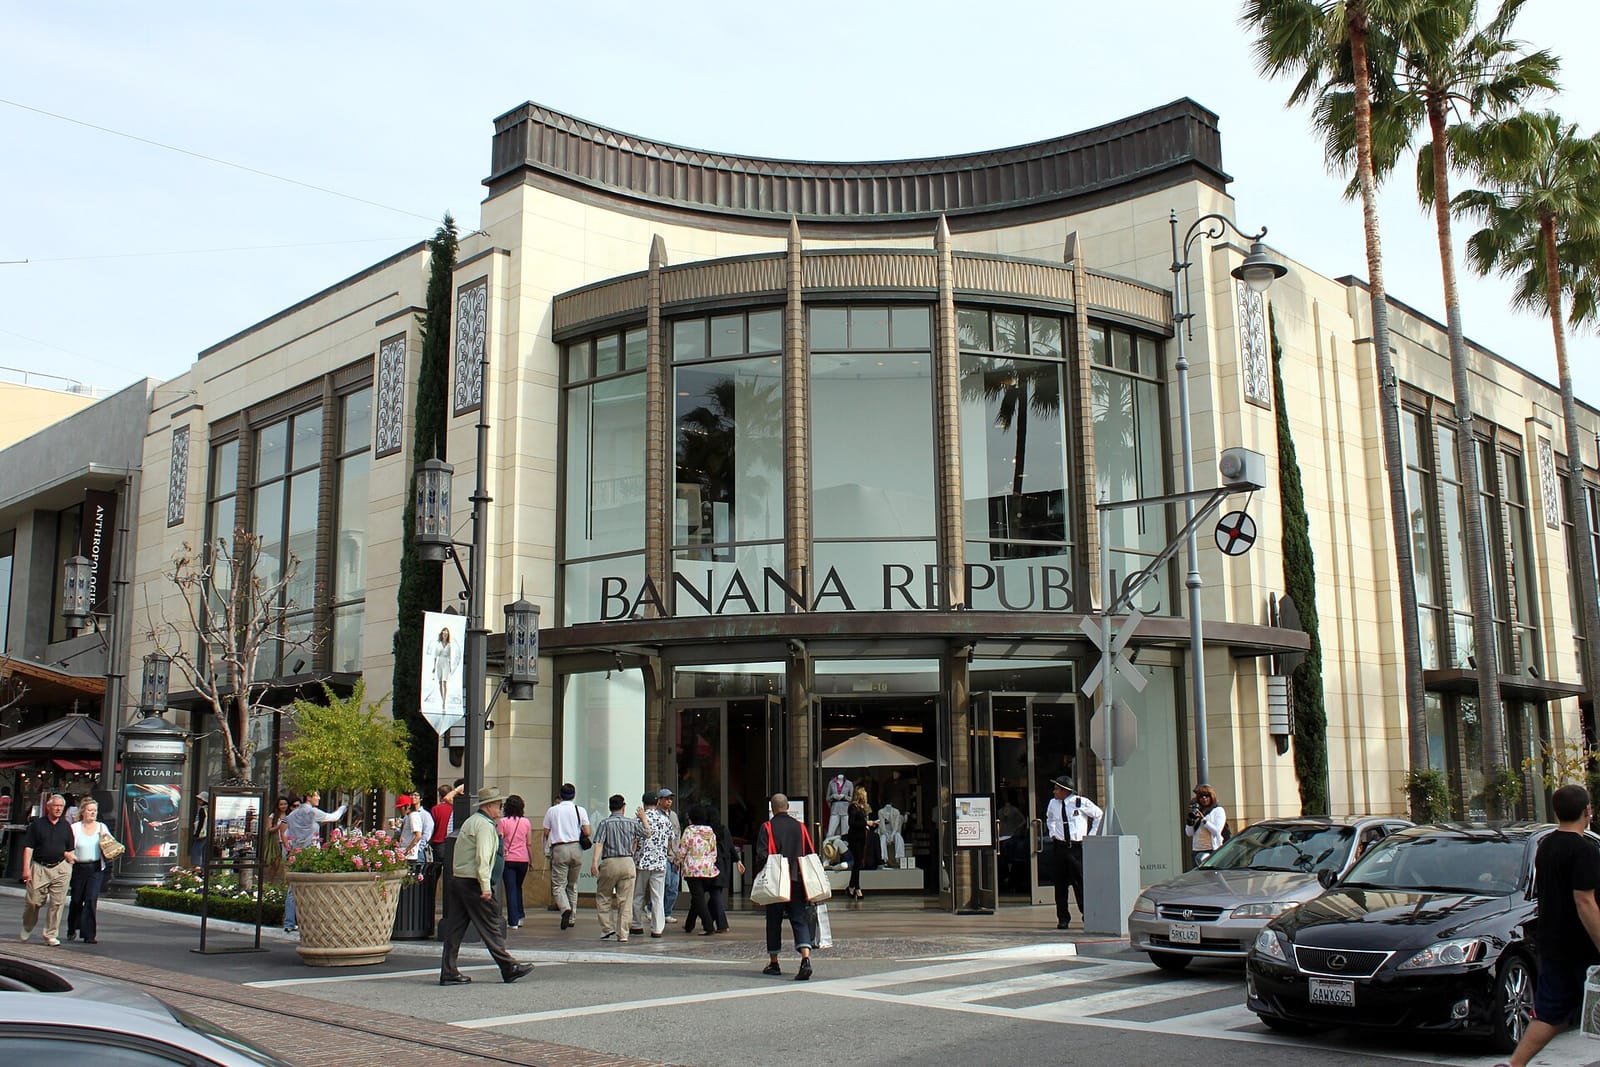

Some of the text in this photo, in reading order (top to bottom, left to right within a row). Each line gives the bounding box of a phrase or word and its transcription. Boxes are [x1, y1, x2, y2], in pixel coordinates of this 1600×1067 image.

[89, 504, 105, 605] ANTHROPOLOGIE
[600, 563, 1161, 620] BANANA REPUBIC
[132, 769, 172, 777] JAGUAR
[958, 826, 978, 835] 25%
[1312, 988, 1352, 1002] 6AWX625
